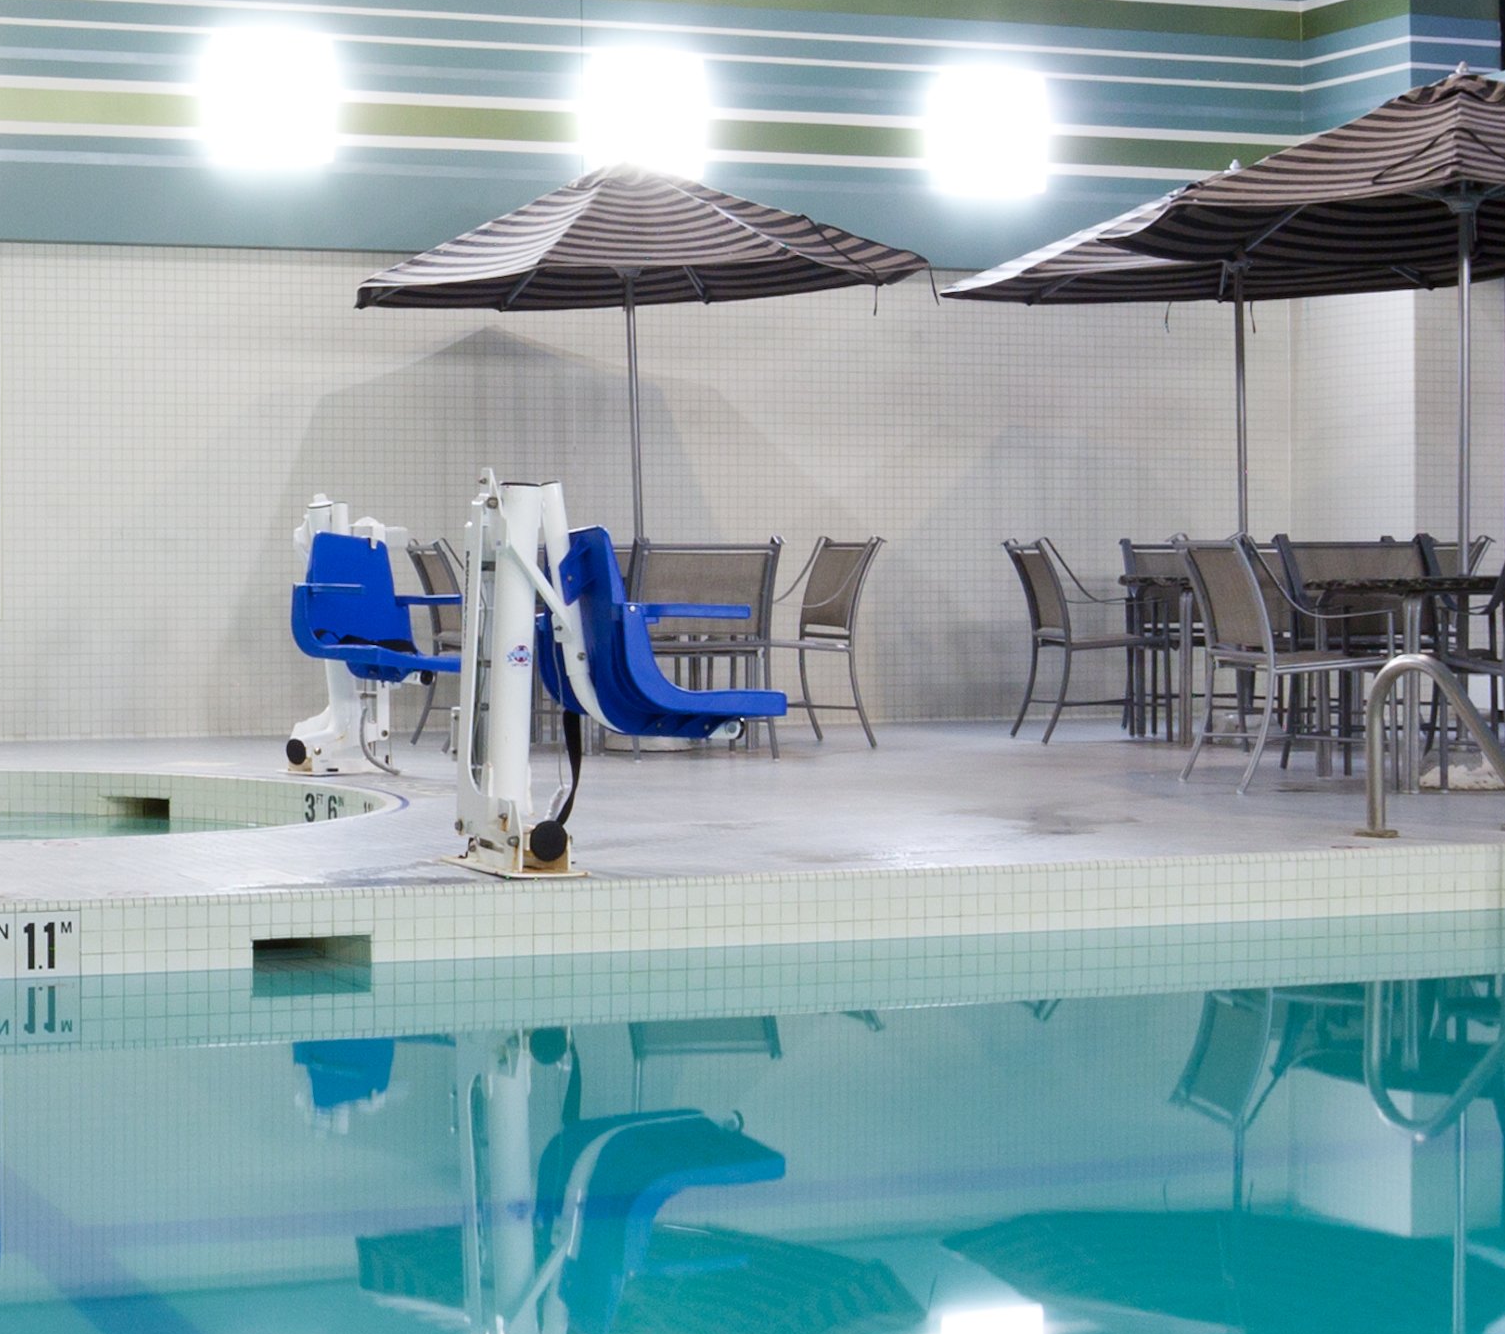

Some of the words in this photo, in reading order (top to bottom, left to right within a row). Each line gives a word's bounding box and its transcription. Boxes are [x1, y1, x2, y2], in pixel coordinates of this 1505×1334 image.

[305, 793, 315, 823] 3
[327, 795, 337, 820] 6
[23, 922, 56, 970] 1.1
[60, 921, 72, 934] M
